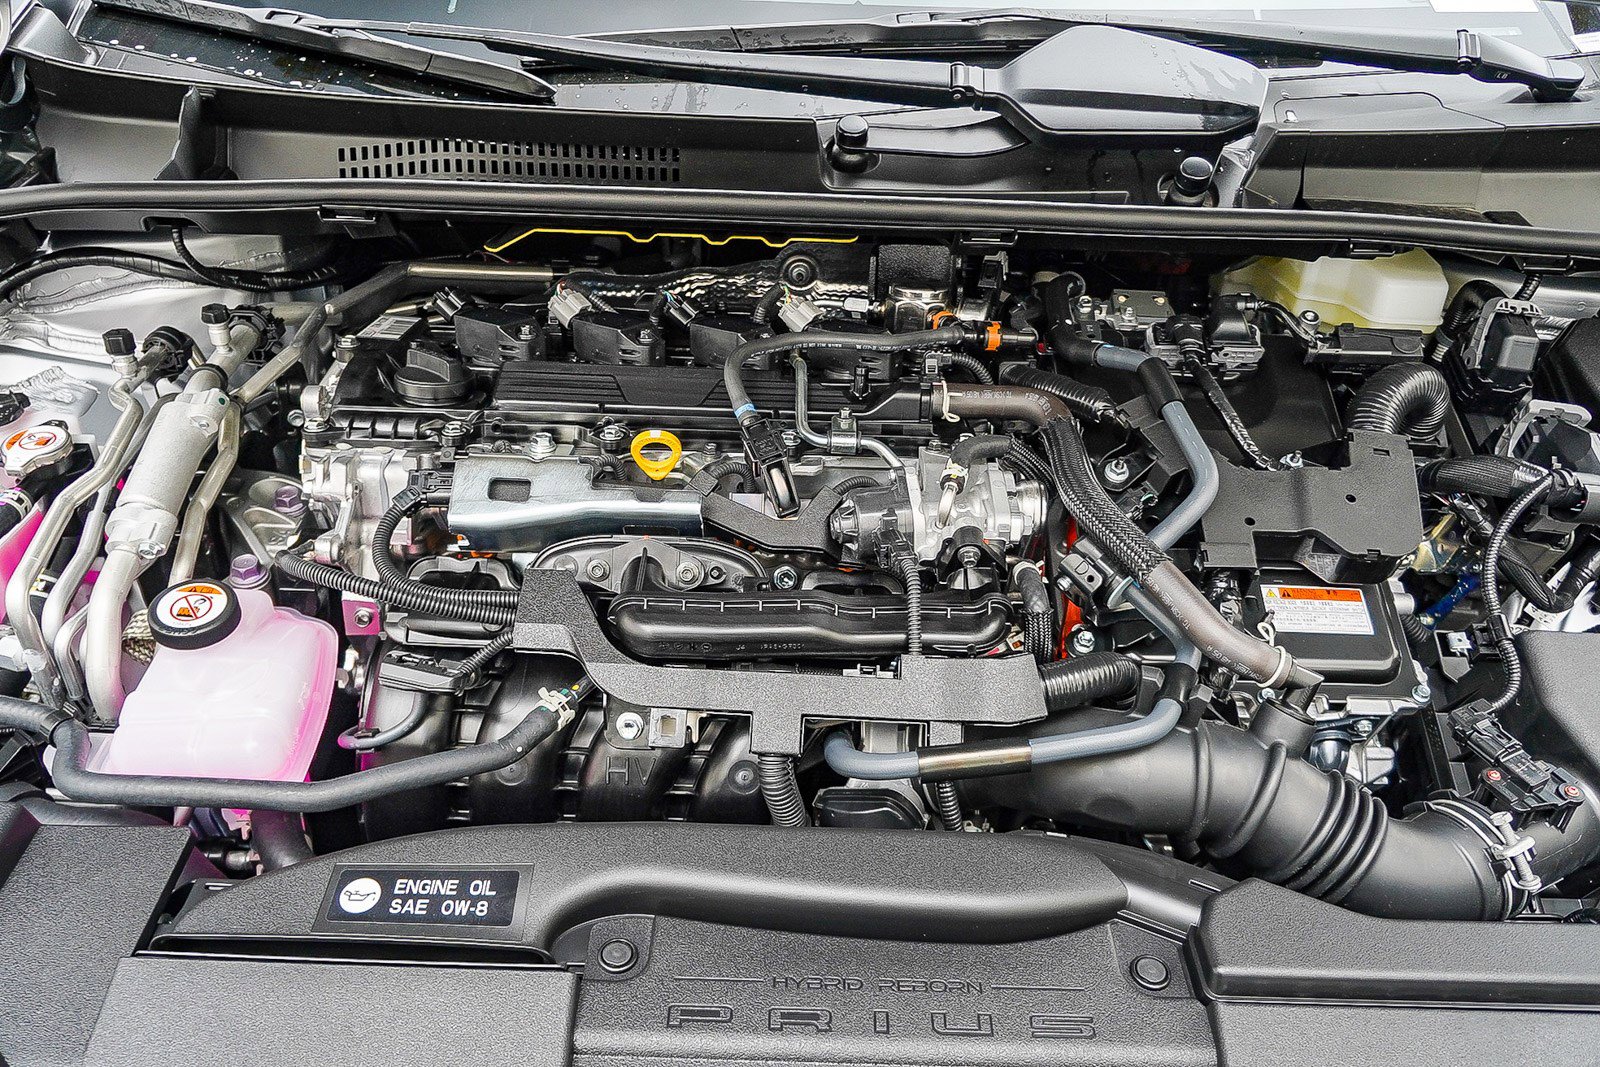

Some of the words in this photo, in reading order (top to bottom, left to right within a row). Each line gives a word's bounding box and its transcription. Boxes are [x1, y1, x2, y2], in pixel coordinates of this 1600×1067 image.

[605, 756, 657, 786] HV
[393, 879, 459, 896] ENGINE
[469, 880, 497, 896] OIL
[389, 899, 430, 915] SAE
[440, 900, 489, 917] 0W-8
[772, 975, 864, 991] HYBRID
[878, 978, 983, 995] REBORN
[667, 1003, 1096, 1039] PRIUS
